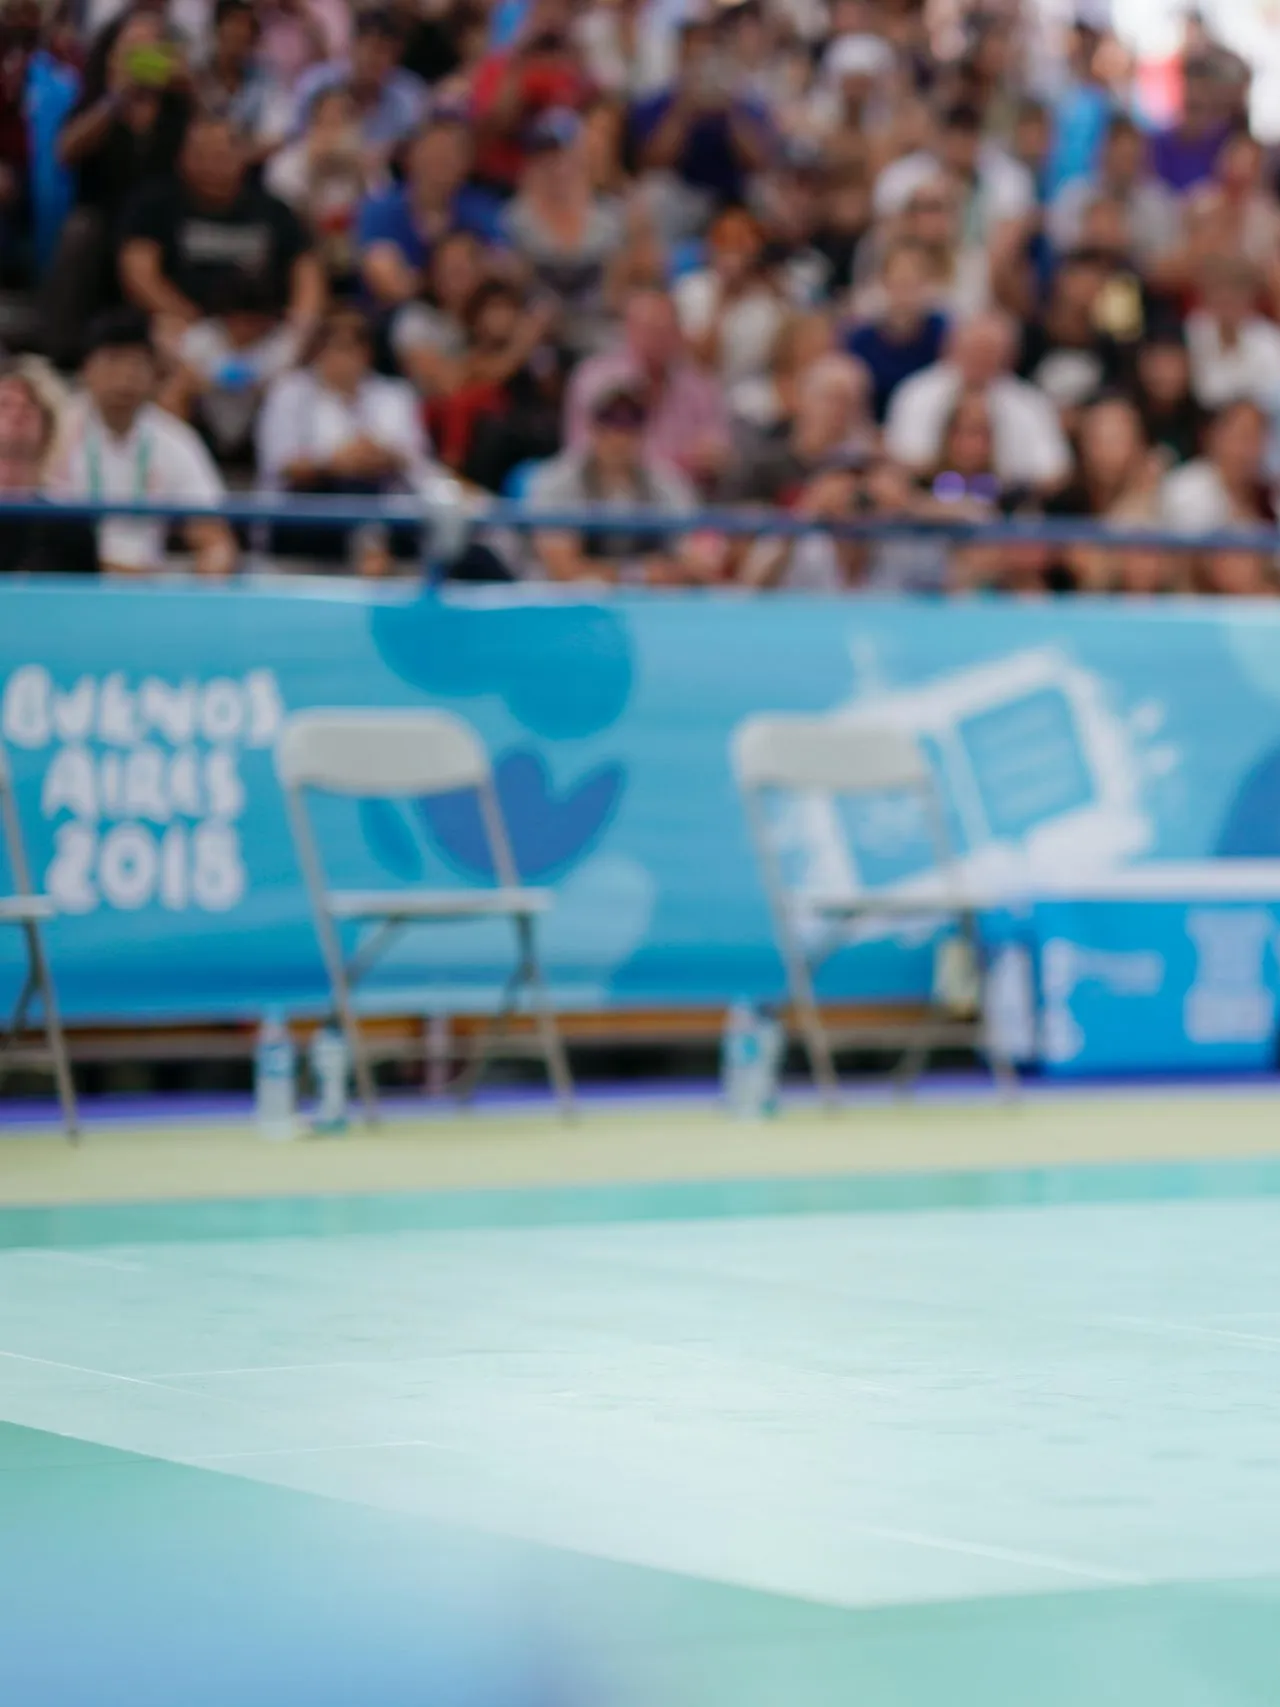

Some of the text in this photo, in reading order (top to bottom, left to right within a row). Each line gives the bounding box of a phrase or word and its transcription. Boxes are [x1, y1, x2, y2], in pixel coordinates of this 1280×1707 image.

[4, 664, 282, 748] BUENOS
[42, 742, 245, 824] AIRES
[46, 819, 246, 913] 2018
